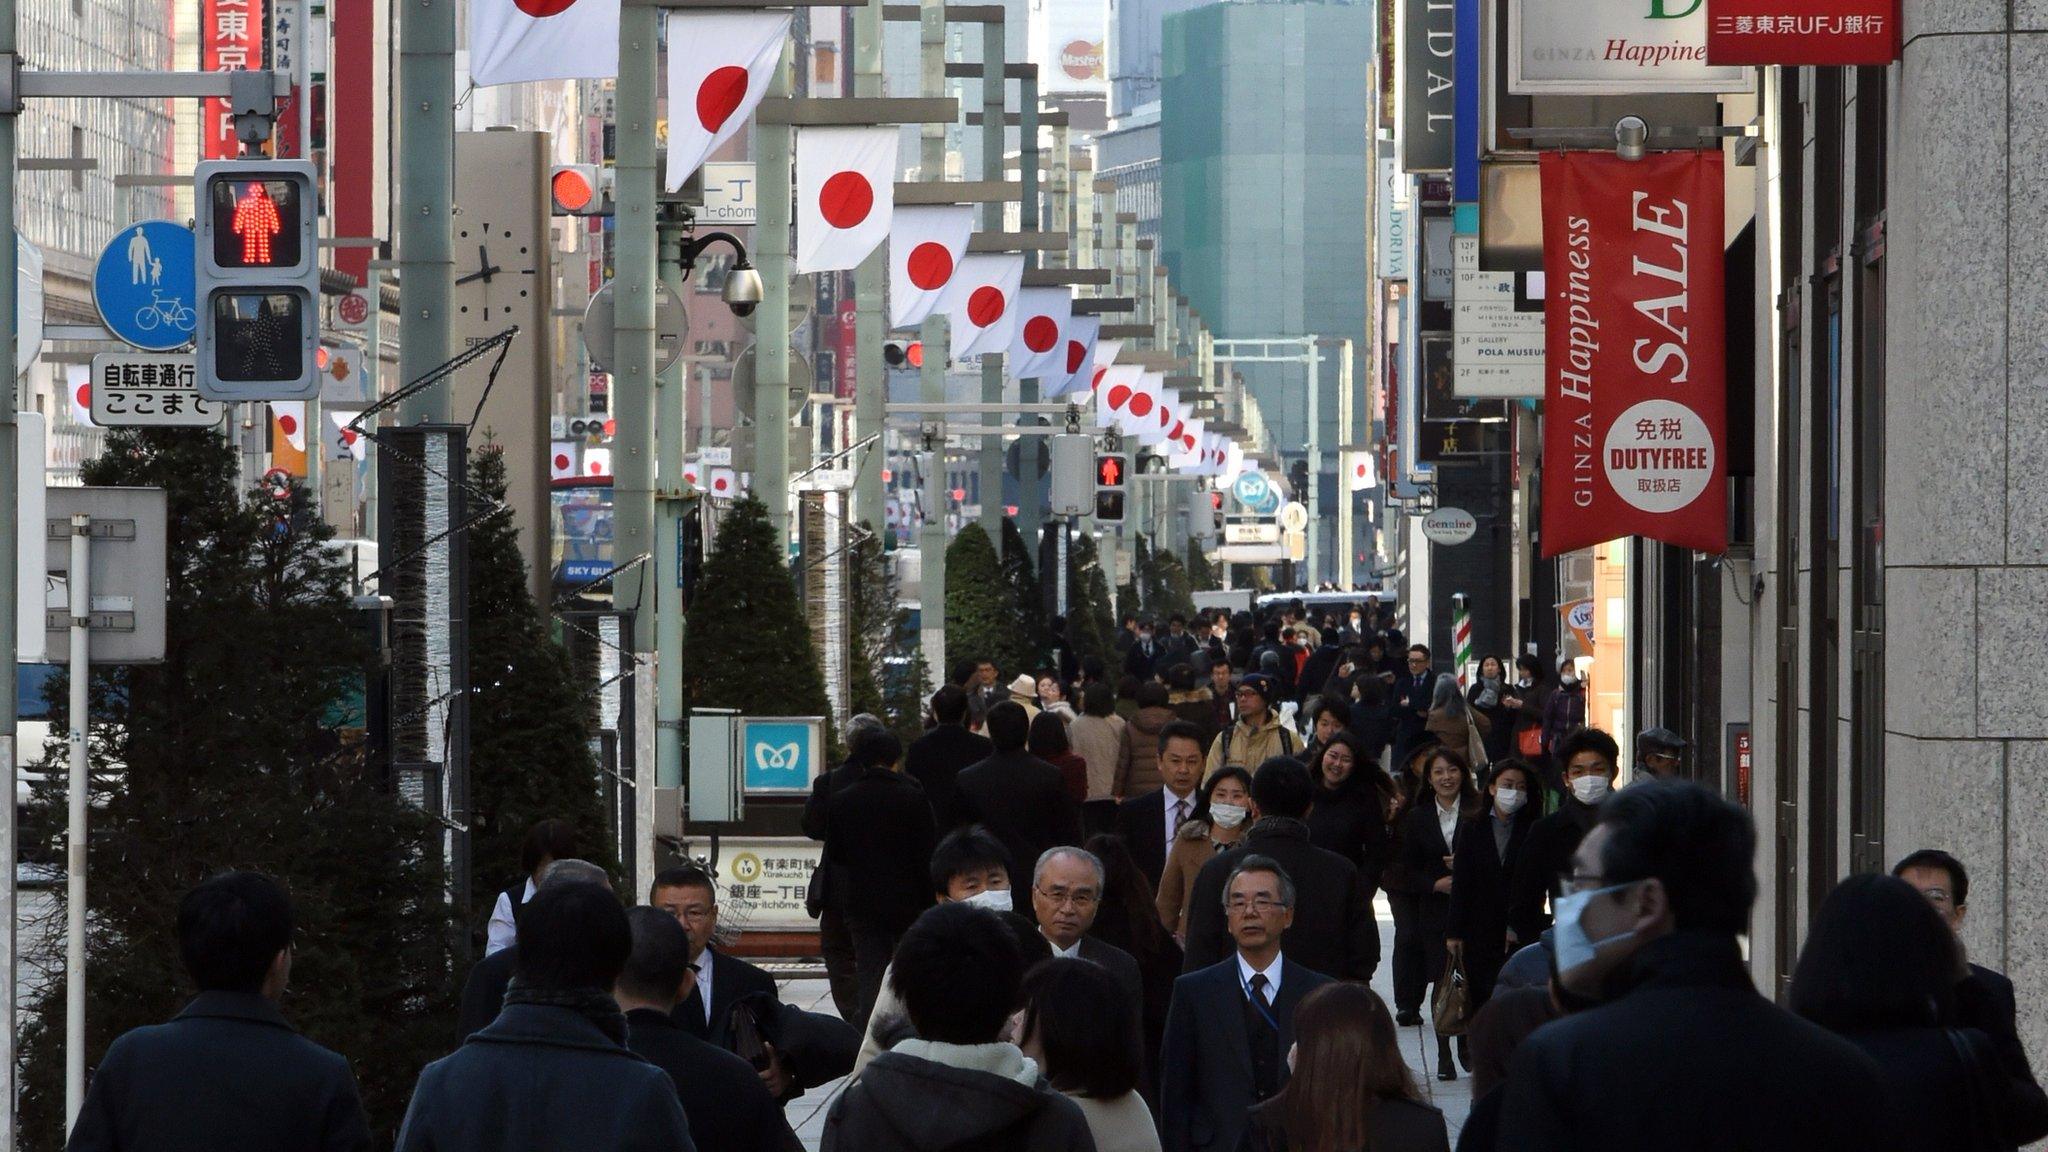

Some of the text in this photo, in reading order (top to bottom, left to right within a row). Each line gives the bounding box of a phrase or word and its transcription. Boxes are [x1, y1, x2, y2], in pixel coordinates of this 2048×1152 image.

[1716, 15, 1884, 34] 三菱東京UFJ銀行
[1532, 48, 1596, 61] GINZA
[1461, 242, 1475, 250] 12F
[1461, 255, 1475, 263] 11F
[1461, 273, 1475, 281] 10F
[1632, 190, 1689, 384] SALE
[1461, 305, 1471, 313] 4F
[1461, 337, 1471, 345] 3F
[1478, 348, 1504, 356] POLA
[1560, 215, 1600, 507] GINZA Happiness
[104, 363, 195, 387] 自転車通行
[1461, 368, 1471, 377] 2F
[1635, 418, 1682, 441] 免税
[1611, 448, 1707, 469] DUTYFREE
[1638, 479, 1681, 493] 取扱店
[567, 566, 589, 576] SKY
[763, 858, 817, 871] 有楽町線
[730, 884, 806, 900] 銀座一丁目
